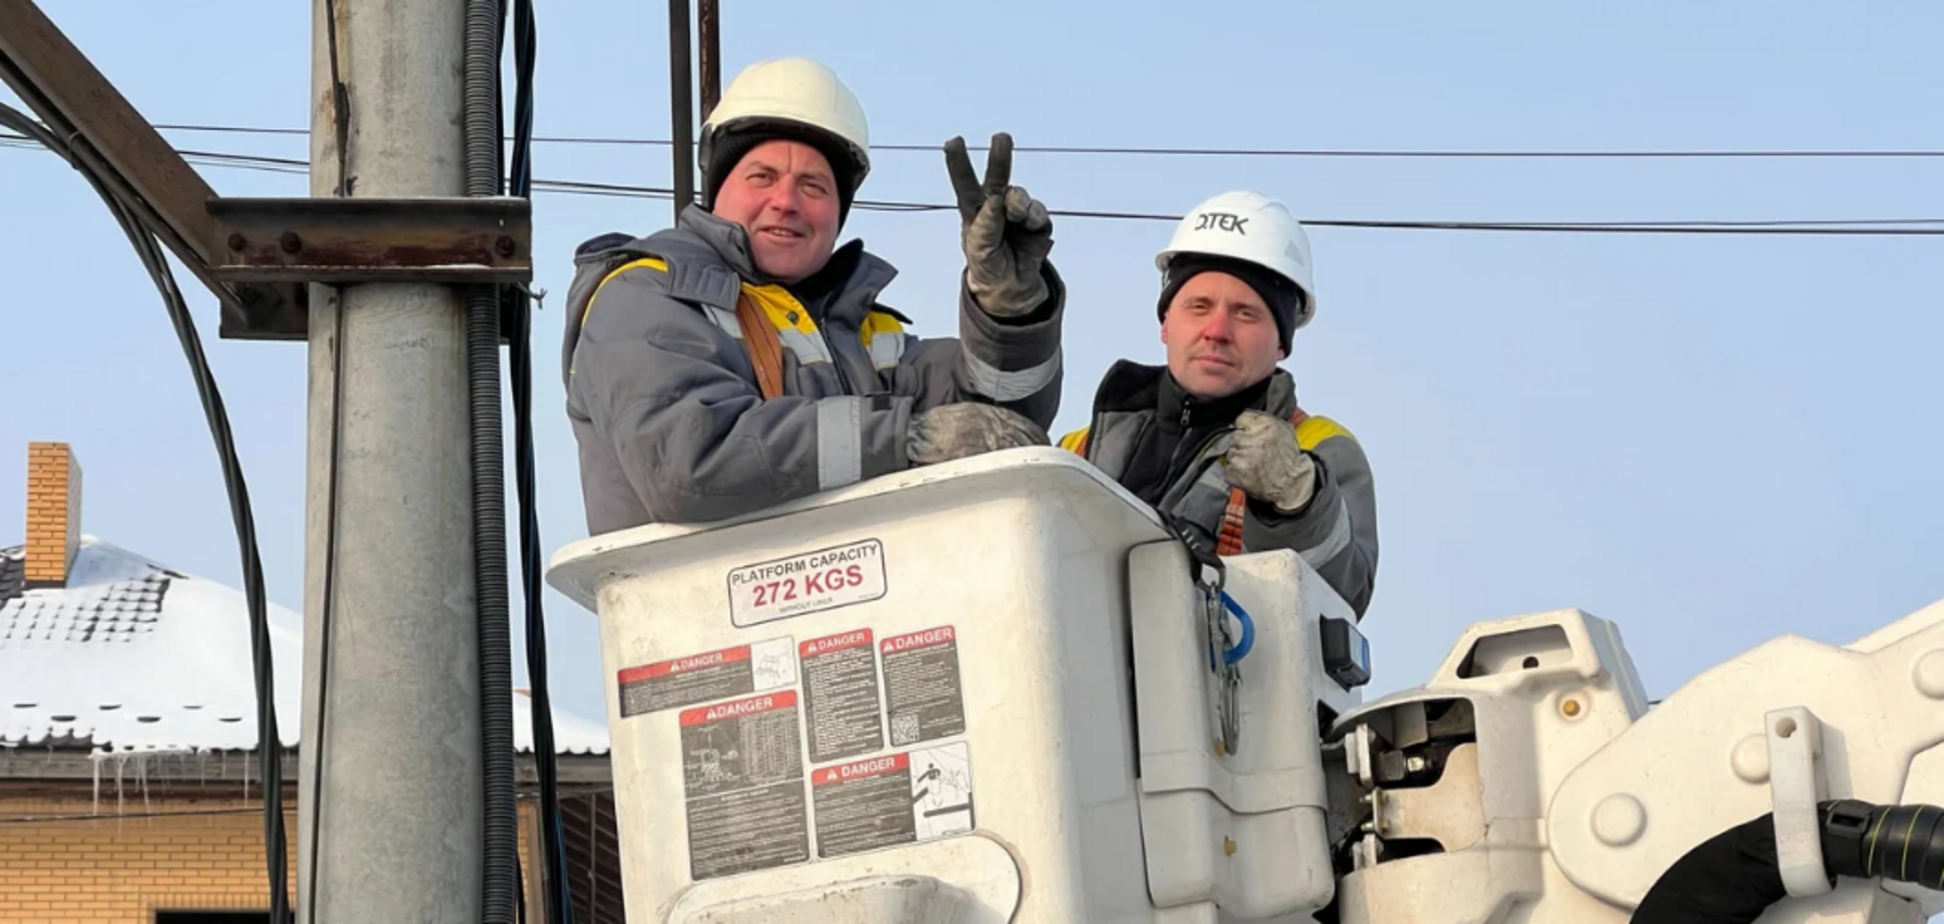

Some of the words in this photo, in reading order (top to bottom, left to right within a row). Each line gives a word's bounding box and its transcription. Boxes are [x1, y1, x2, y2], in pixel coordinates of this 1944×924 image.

[732, 560, 806, 586] PLATFORM
[809, 544, 878, 570] CAPACITY
[752, 578, 797, 608] 272
[805, 564, 864, 596] KGS
[818, 632, 865, 650] DANGER
[896, 627, 953, 650] DANGER
[680, 652, 723, 669] DANGER
[715, 696, 774, 718] DANGER
[841, 757, 896, 777] DANGER
